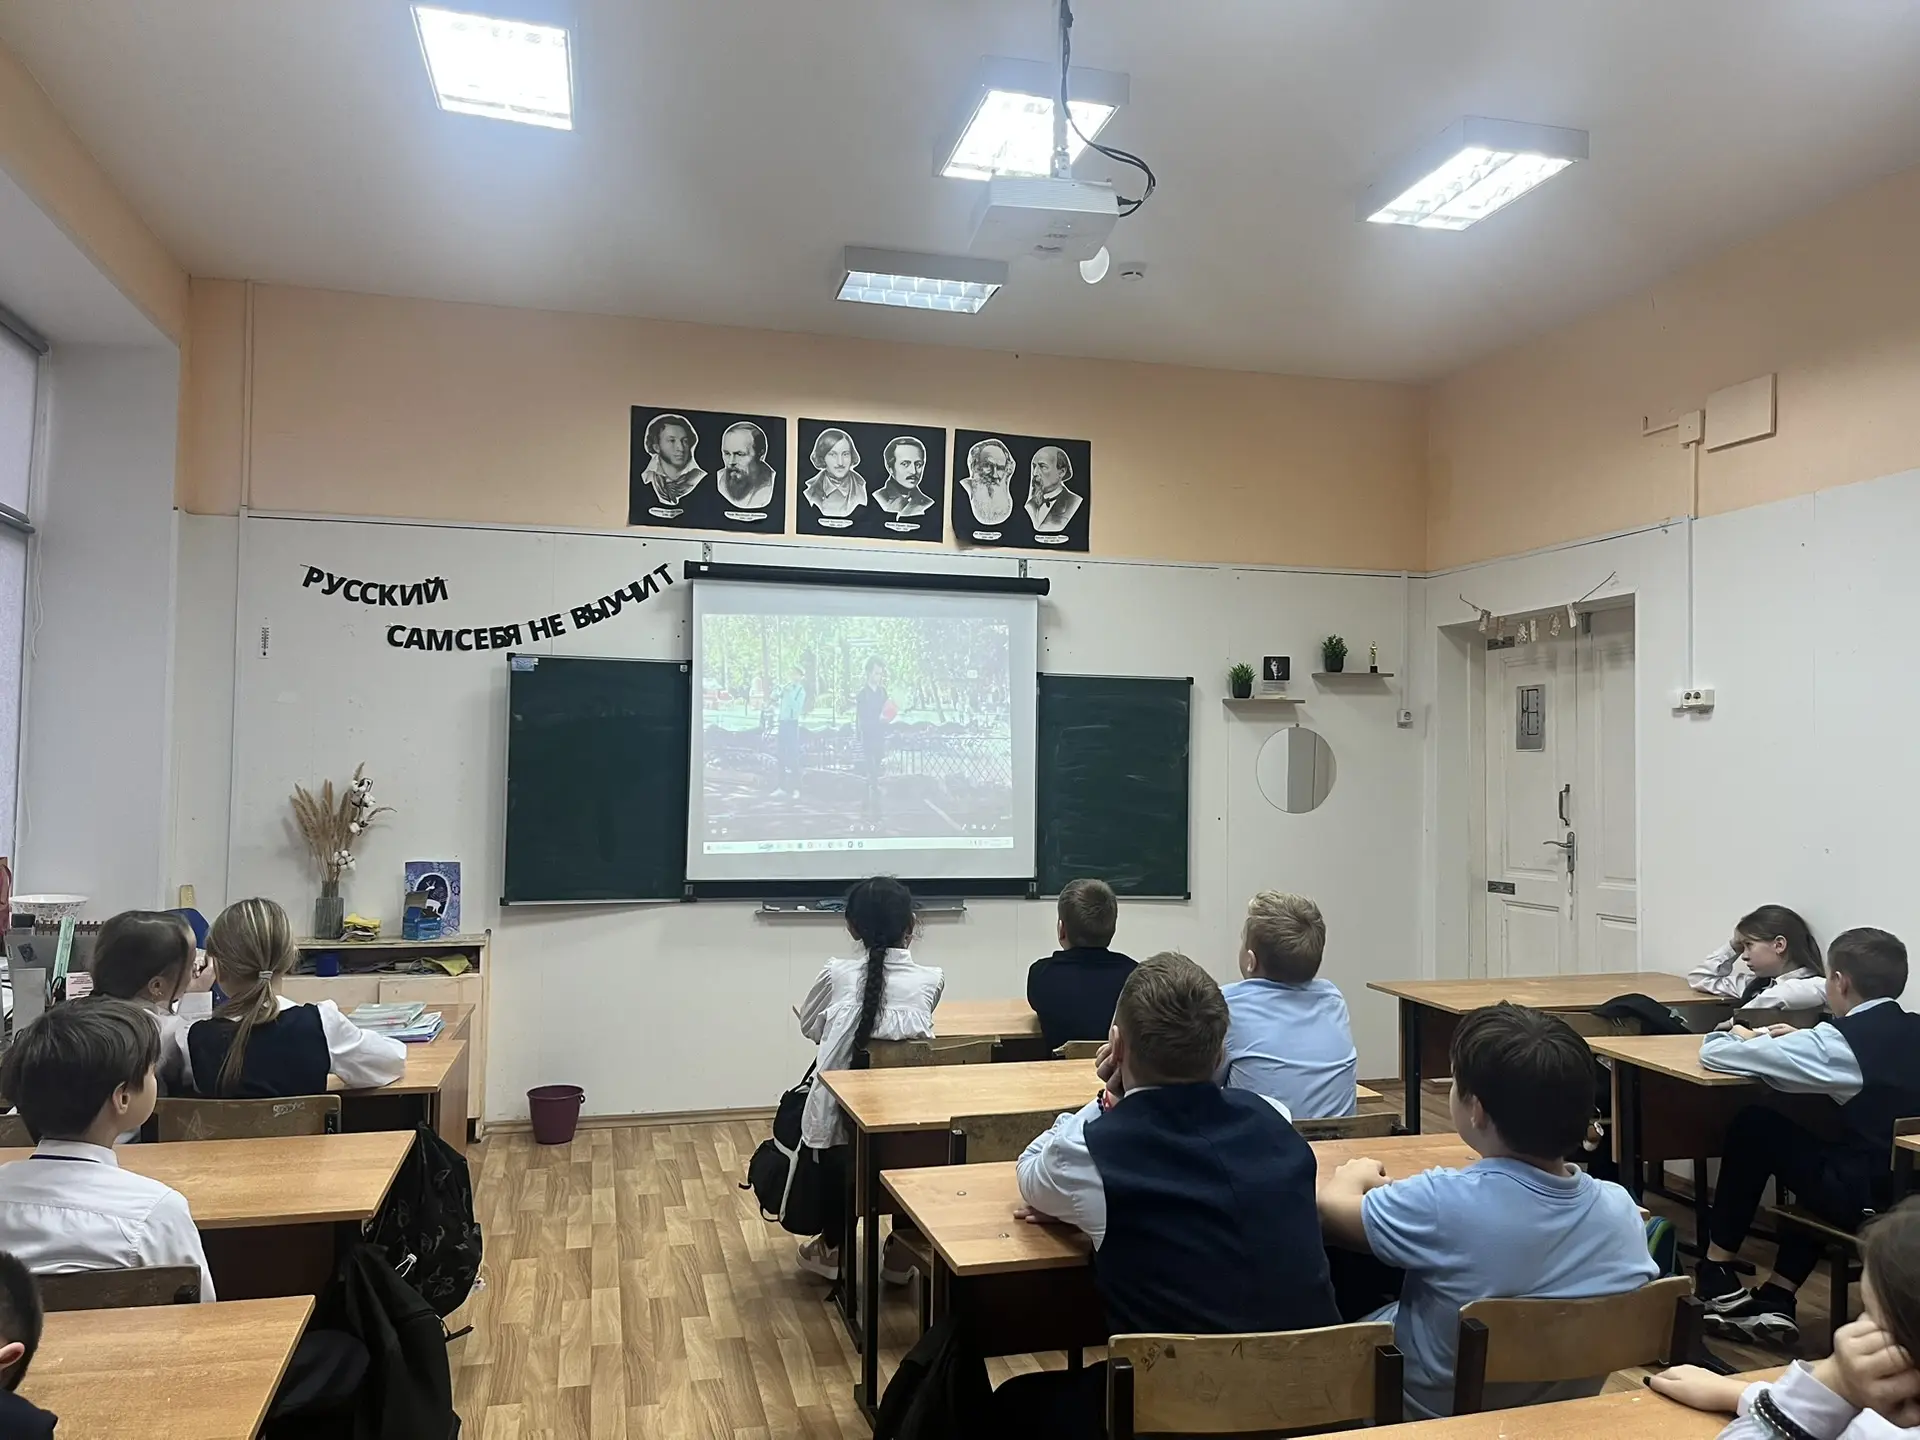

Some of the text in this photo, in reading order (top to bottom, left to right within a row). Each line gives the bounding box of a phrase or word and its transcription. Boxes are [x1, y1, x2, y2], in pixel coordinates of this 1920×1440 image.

[302, 566, 448, 606] РУССКИЙ
[528, 614, 566, 642] НЕ
[570, 564, 674, 629] ВЫУЧИТ
